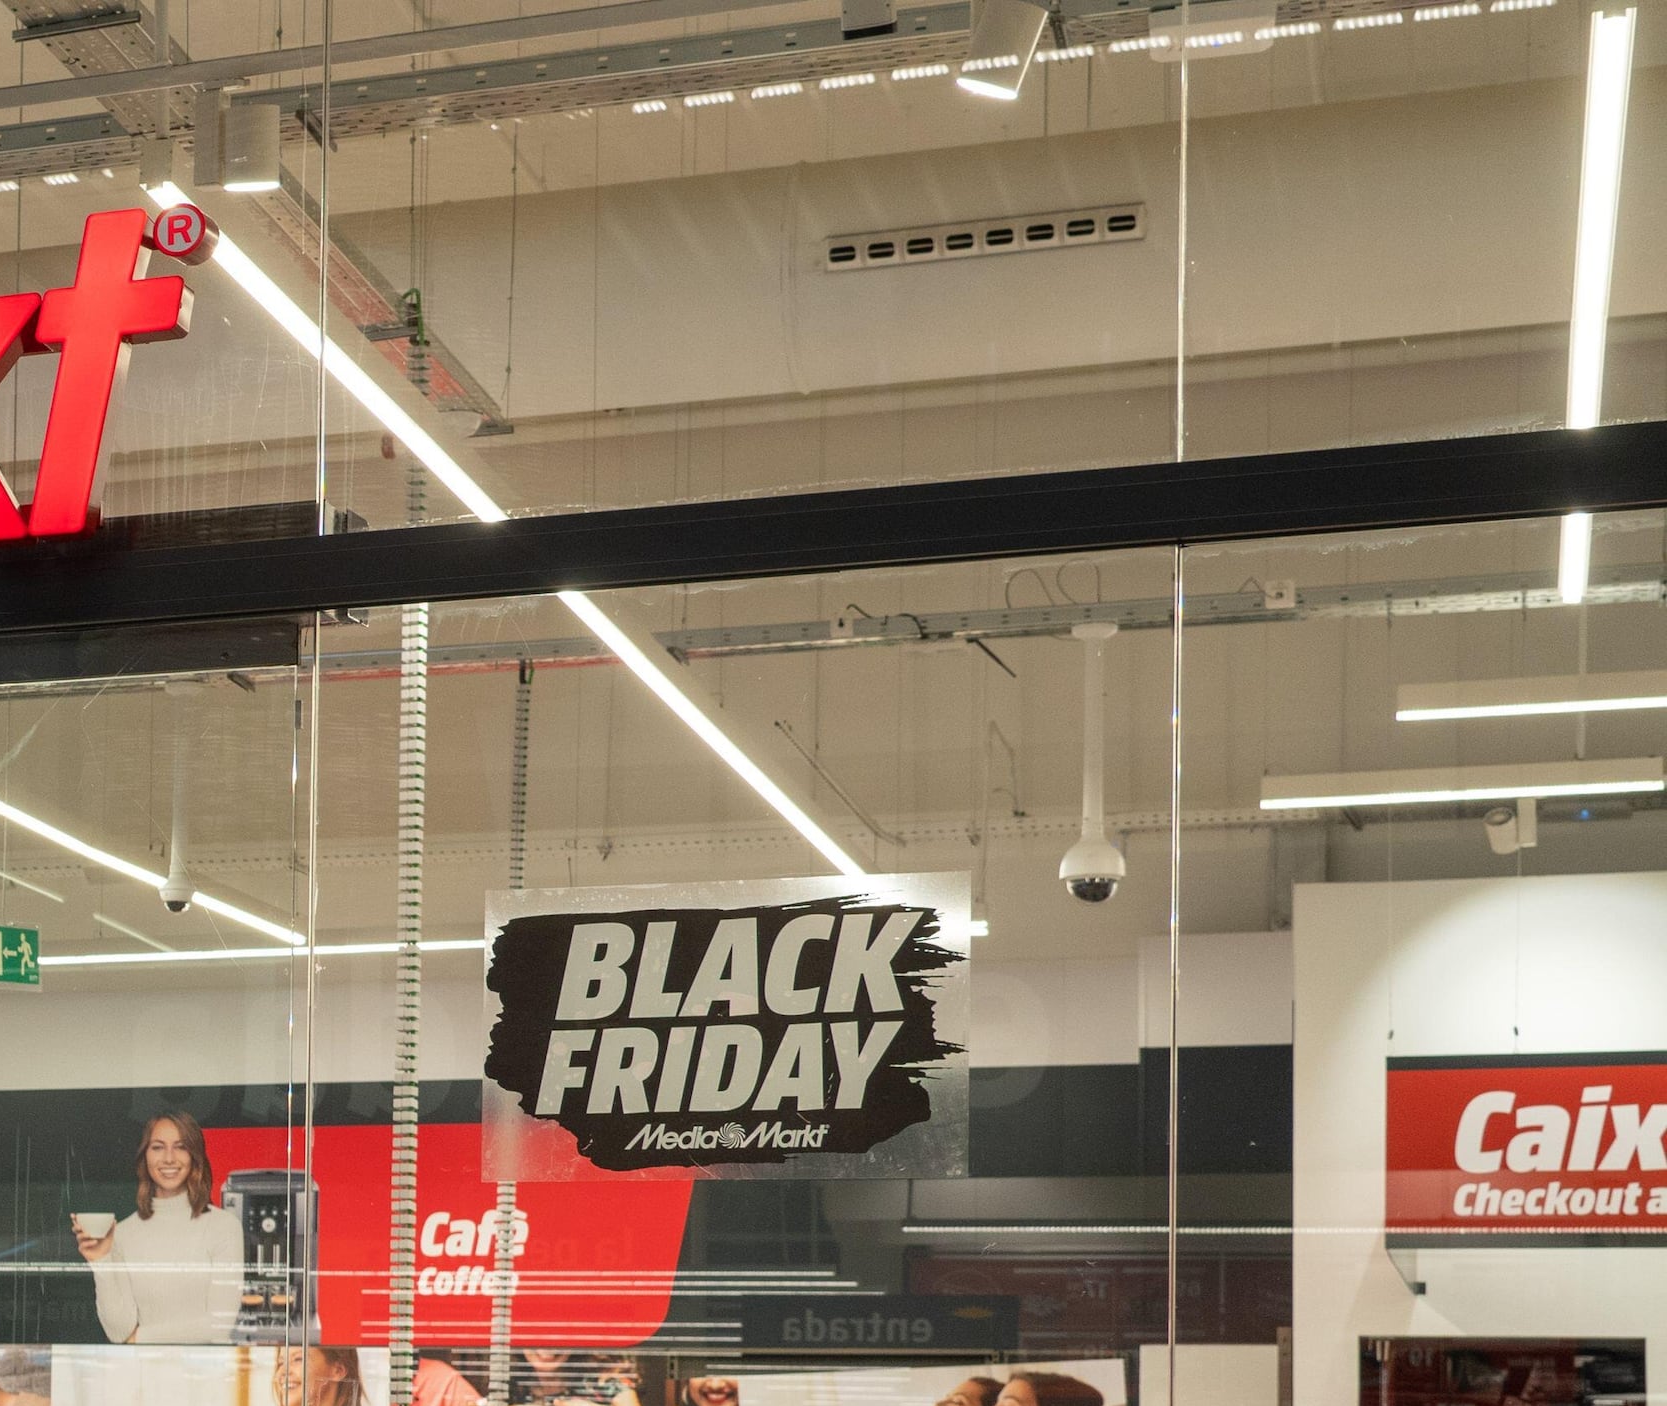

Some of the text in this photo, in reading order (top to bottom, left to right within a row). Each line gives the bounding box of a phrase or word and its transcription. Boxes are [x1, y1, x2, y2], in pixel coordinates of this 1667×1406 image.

[555, 911, 924, 1021] BLACK
[534, 1020, 904, 1115] FRIDAY
[1453, 1181, 1642, 1216] Checkout
